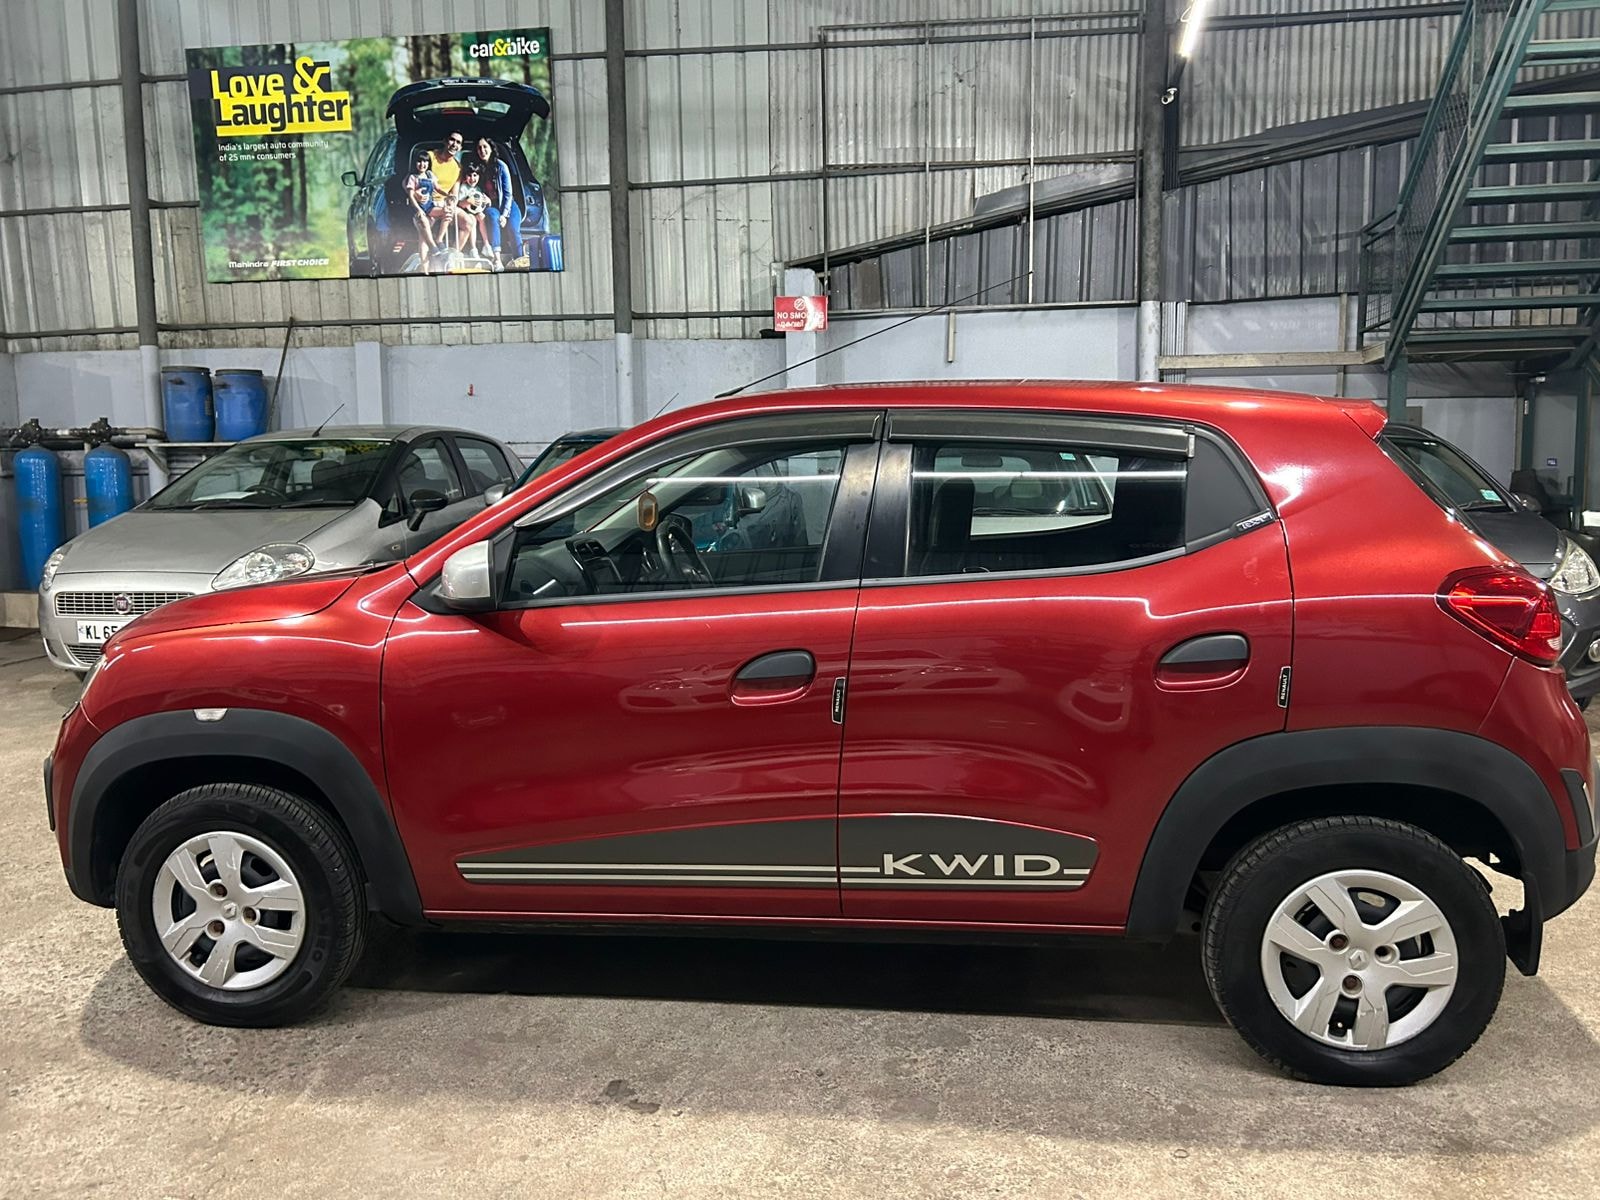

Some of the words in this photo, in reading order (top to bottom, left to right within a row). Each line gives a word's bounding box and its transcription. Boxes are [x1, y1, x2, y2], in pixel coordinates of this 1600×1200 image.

[470, 37, 540, 57] car&bike
[211, 70, 284, 99] Love
[293, 56, 330, 95] &
[215, 95, 348, 132] Laughter
[218, 143, 242, 151] India's
[243, 142, 268, 151] largest
[288, 141, 329, 149] community
[219, 153, 227, 161] of
[229, 153, 239, 161] 25
[257, 153, 296, 161] consumers
[270, 259, 298, 267] FIRST
[298, 258, 329, 266] CHOICE
[790, 311, 824, 319] SMONG
[86, 625, 101, 639] KL
[1280, 674, 1288, 700] RENAULT
[882, 853, 1062, 878] KWID
